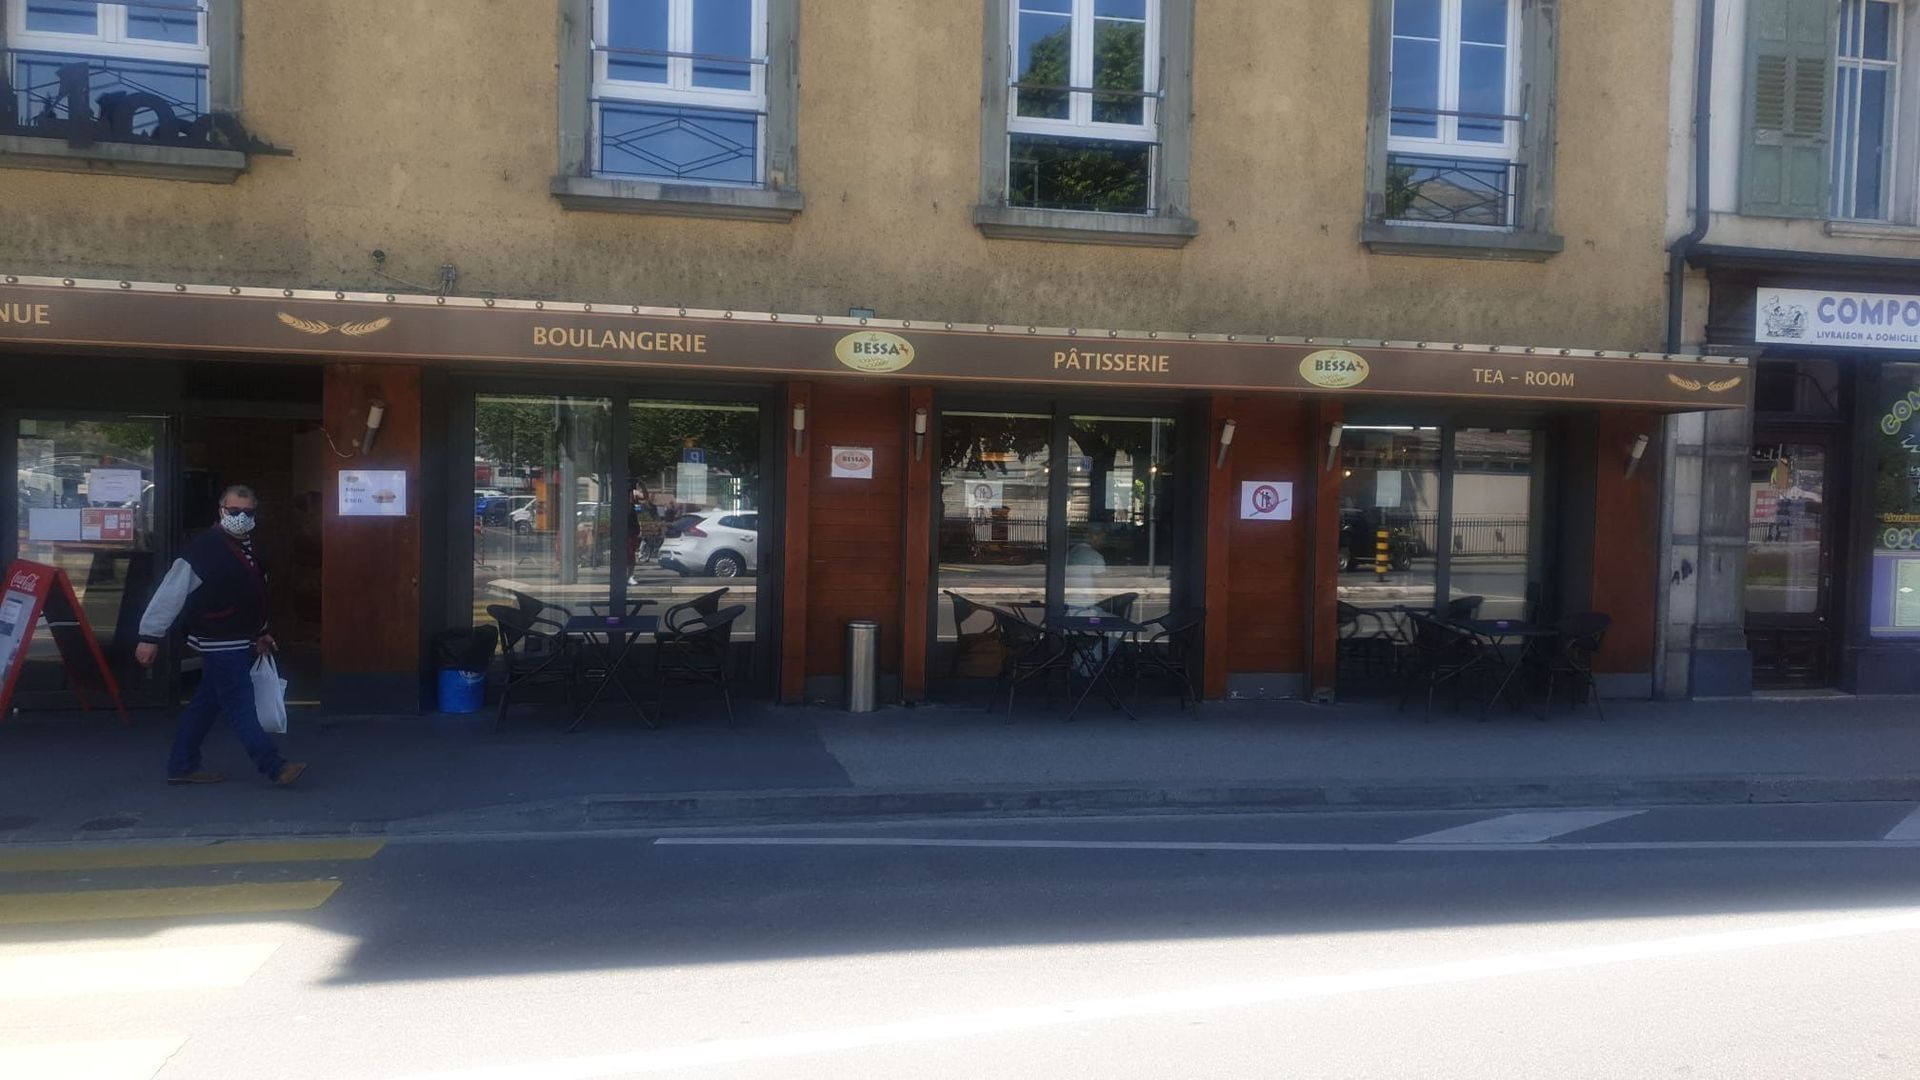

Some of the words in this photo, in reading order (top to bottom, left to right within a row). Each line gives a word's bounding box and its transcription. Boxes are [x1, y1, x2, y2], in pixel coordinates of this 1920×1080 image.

[1817, 296, 1920, 327] COMPO
[533, 326, 707, 353] BOULANGERIE
[1816, 331, 1863, 340] LIVRAISON
[1866, 333, 1873, 341] A
[1875, 333, 1919, 343] DOMICILE
[853, 341, 900, 355] BESSA
[1054, 347, 1170, 373] PÂTISSERIE
[1315, 360, 1356, 372] BESSA
[1472, 368, 1505, 384] TEA
[1525, 370, 1575, 387] ROOM
